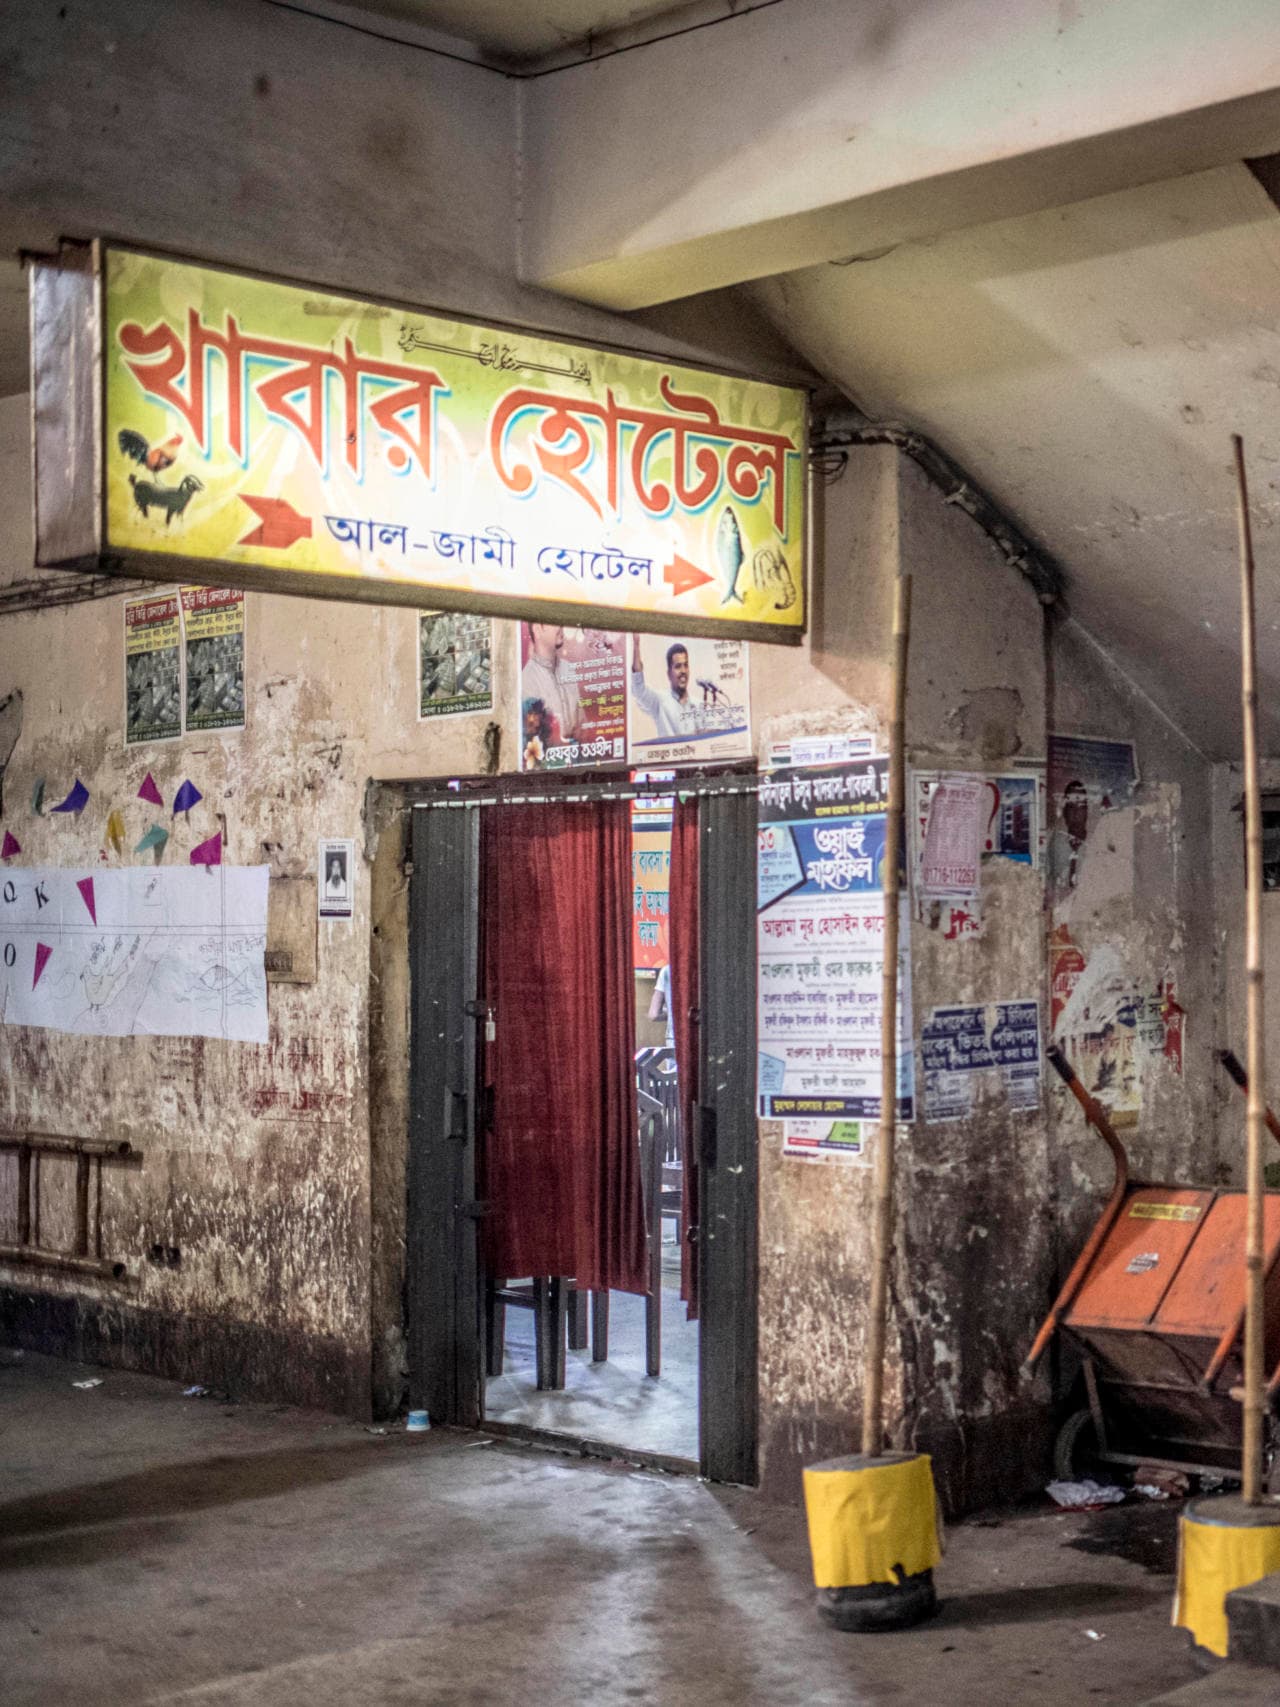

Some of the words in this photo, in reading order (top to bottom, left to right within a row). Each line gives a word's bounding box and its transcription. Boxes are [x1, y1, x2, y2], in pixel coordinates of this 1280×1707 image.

[118, 306, 450, 481] খাবার
[491, 374, 802, 533] হোটেল
[326, 515, 516, 570] আল-জামী
[537, 544, 654, 587] হোটেল
[545, 742, 580, 763] হেযবুত
[581, 736, 612, 757] তওহীদ
[806, 852, 873, 892] মাহফিল
[3, 880, 17, 903] Q
[34, 880, 50, 910] K
[762, 919, 796, 938] আল্লামা
[819, 913, 859, 935] হোসাইন
[796, 956, 820, 982] মুফতী
